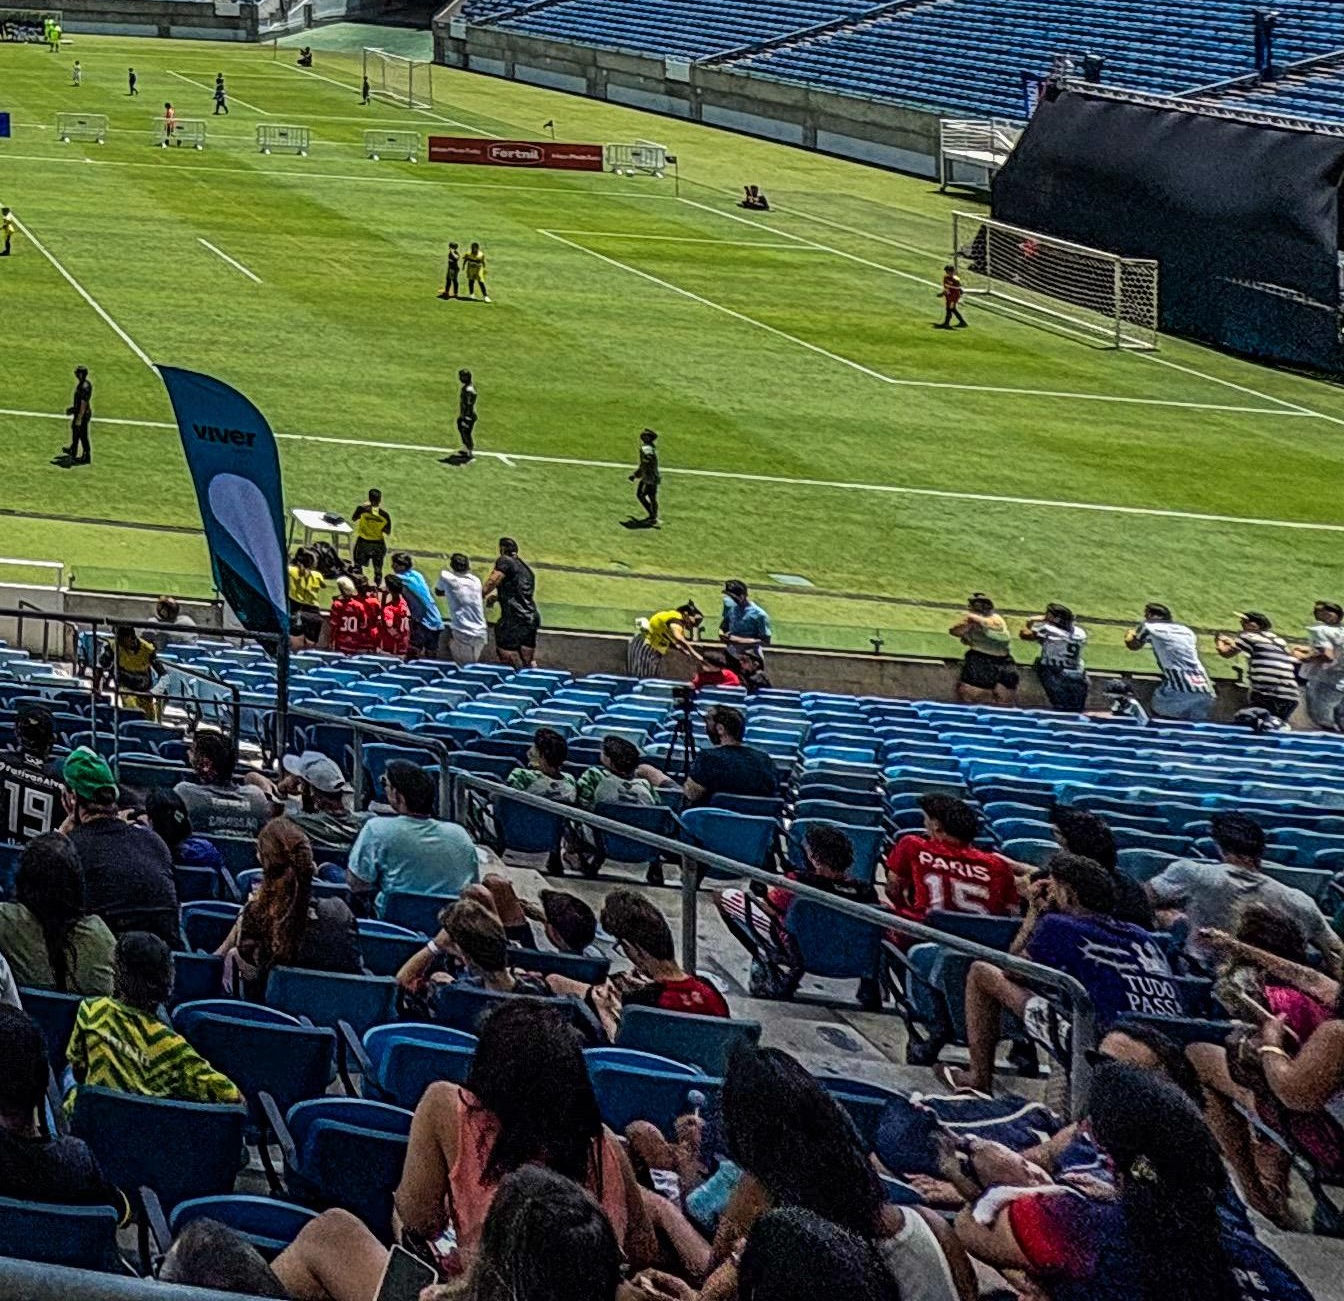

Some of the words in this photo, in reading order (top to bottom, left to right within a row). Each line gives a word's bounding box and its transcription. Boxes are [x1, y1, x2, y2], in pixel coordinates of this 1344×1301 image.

[191, 422, 258, 449] viver
[339, 616, 358, 633] 30
[3, 779, 54, 838] 19
[918, 850, 991, 882] PARIS
[923, 872, 991, 916] 15
[1121, 972, 1176, 999] TUDO
